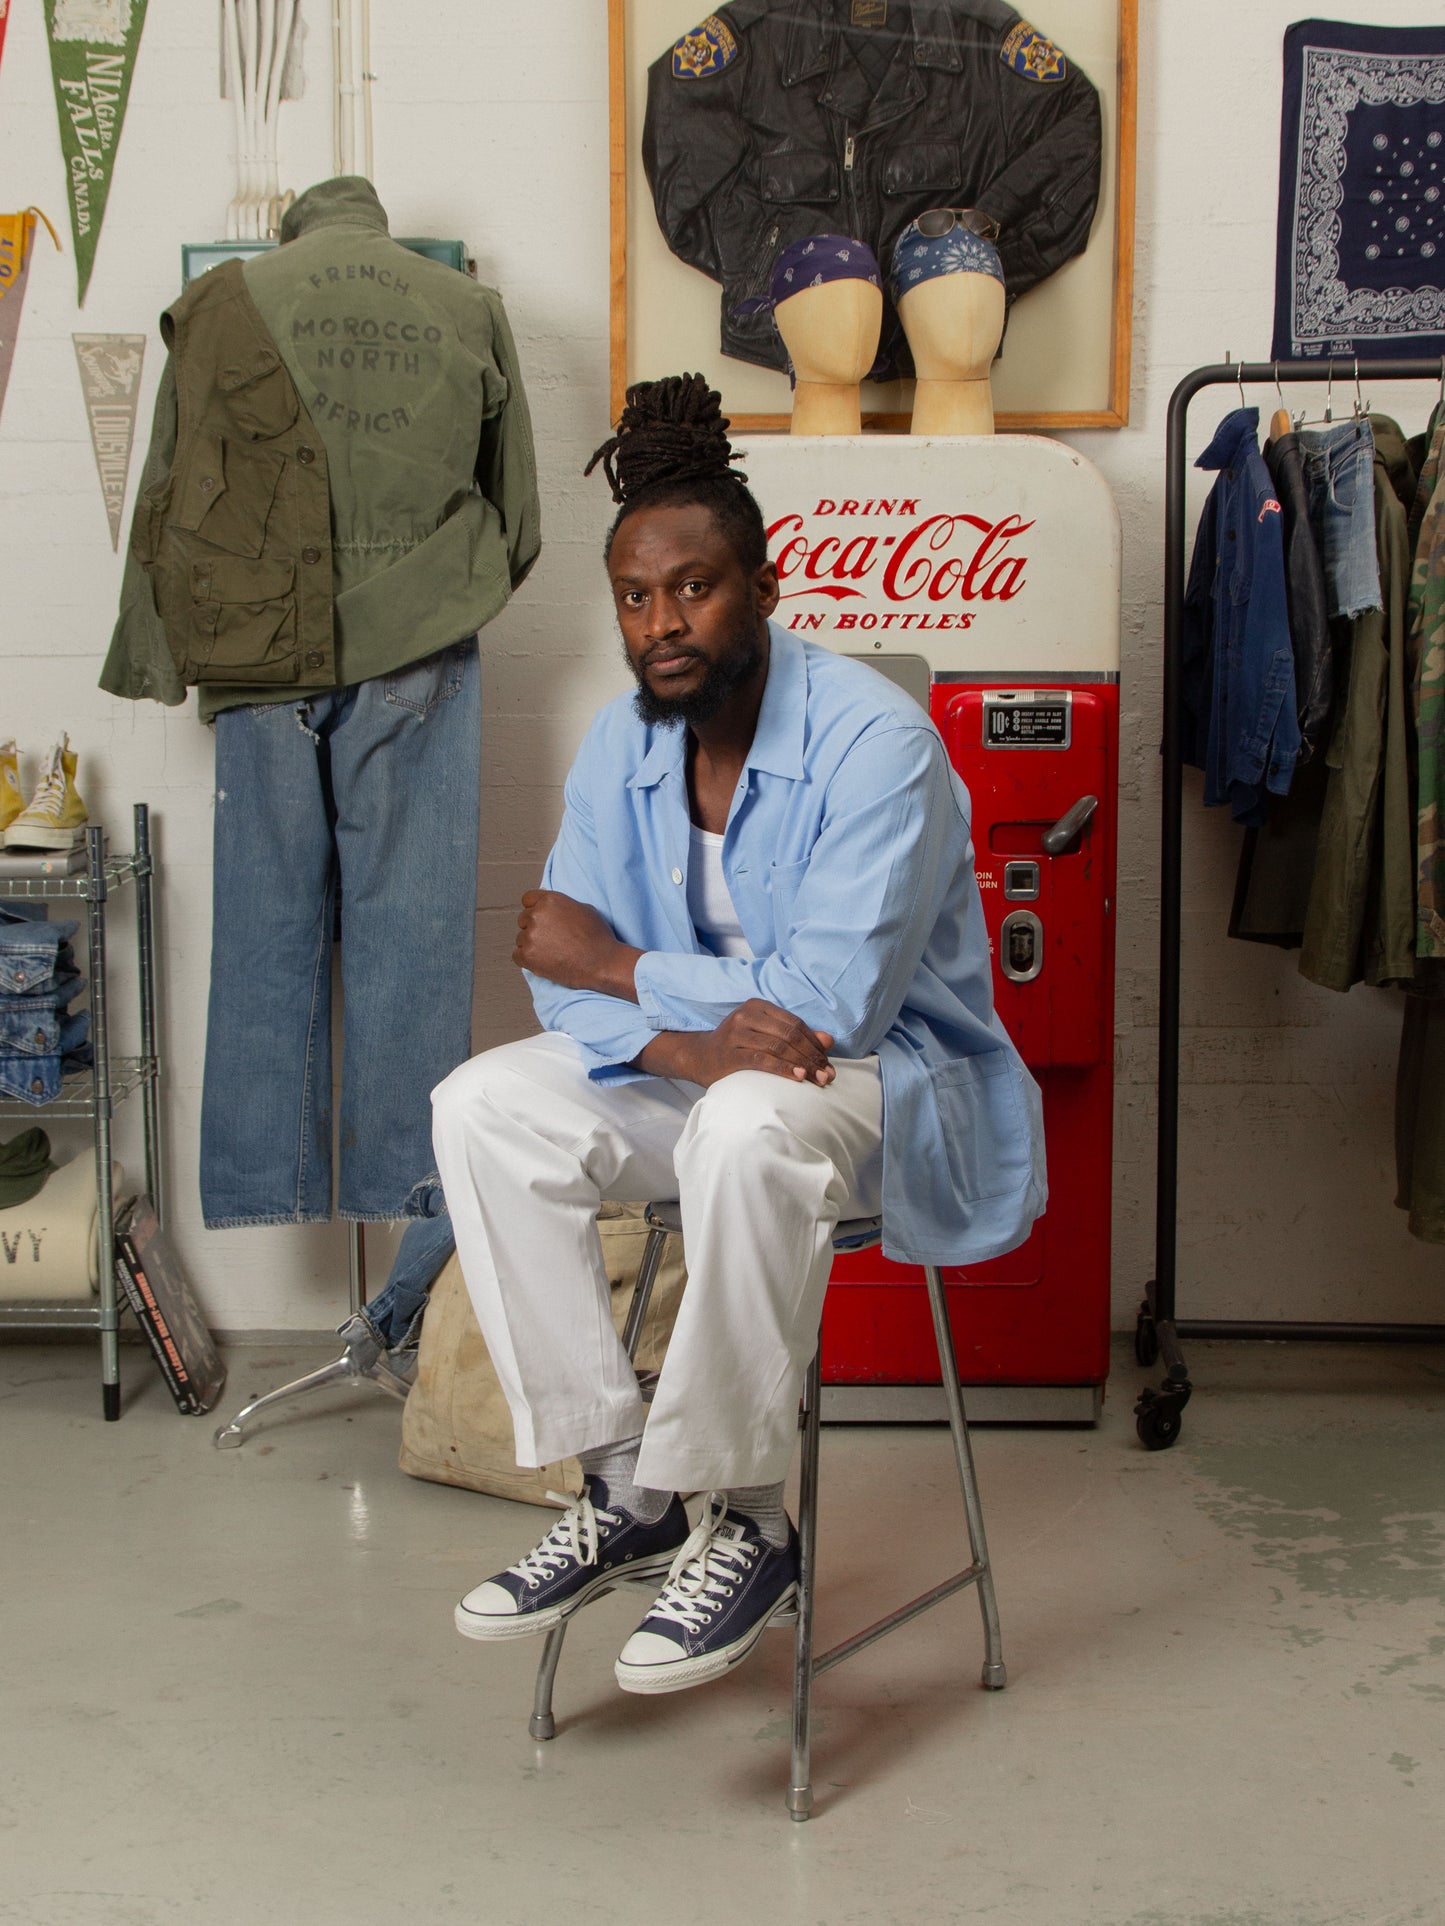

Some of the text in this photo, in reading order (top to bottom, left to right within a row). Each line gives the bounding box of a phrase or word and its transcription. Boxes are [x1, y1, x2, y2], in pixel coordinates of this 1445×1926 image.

[86, 51, 126, 150] NIAGARA
[59, 78, 104, 181] FALLS
[70, 156, 91, 236] CANADA
[309, 264, 410, 296] FRENCH
[292, 316, 442, 344] MOROCCO
[317, 347, 420, 375] NORTH
[313, 391, 410, 434] AFRICA
[812, 498, 922, 516] DRINK
[787, 612, 977, 630] IN BOTTLES
[975, 872, 993, 880] OIN
